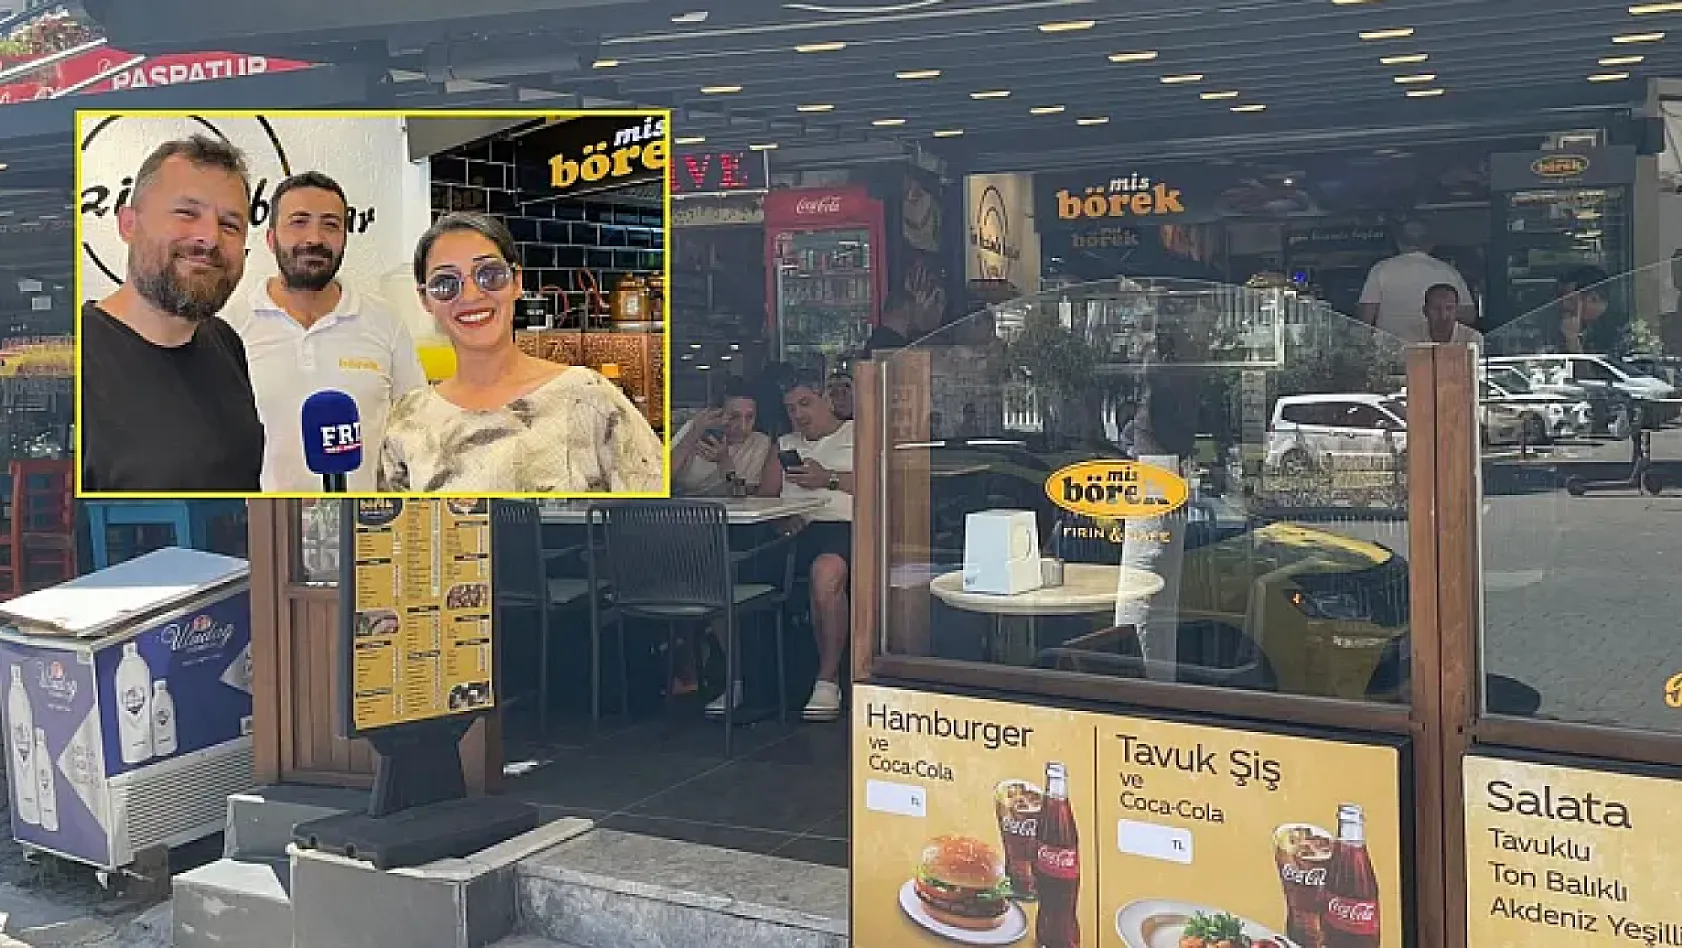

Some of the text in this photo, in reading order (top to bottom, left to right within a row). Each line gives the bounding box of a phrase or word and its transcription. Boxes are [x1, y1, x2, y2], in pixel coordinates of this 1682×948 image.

[1109, 171, 1151, 192] mis
[1056, 182, 1185, 220] börek
[866, 703, 1034, 749] Hamburger
[869, 736, 889, 751] ve
[868, 755, 954, 781] Coca-Cola
[1115, 734, 1282, 792] Tavuk Şiş
[1119, 771, 1144, 789] ve
[1119, 791, 1225, 824] Coca-Cola
[1487, 781, 1633, 829] Salata
[1171, 838, 1185, 851] TL
[1488, 828, 1591, 862] Tavuklu
[1488, 861, 1628, 902] Ton Balıklı
[1490, 896, 1598, 932] Akdeniz
